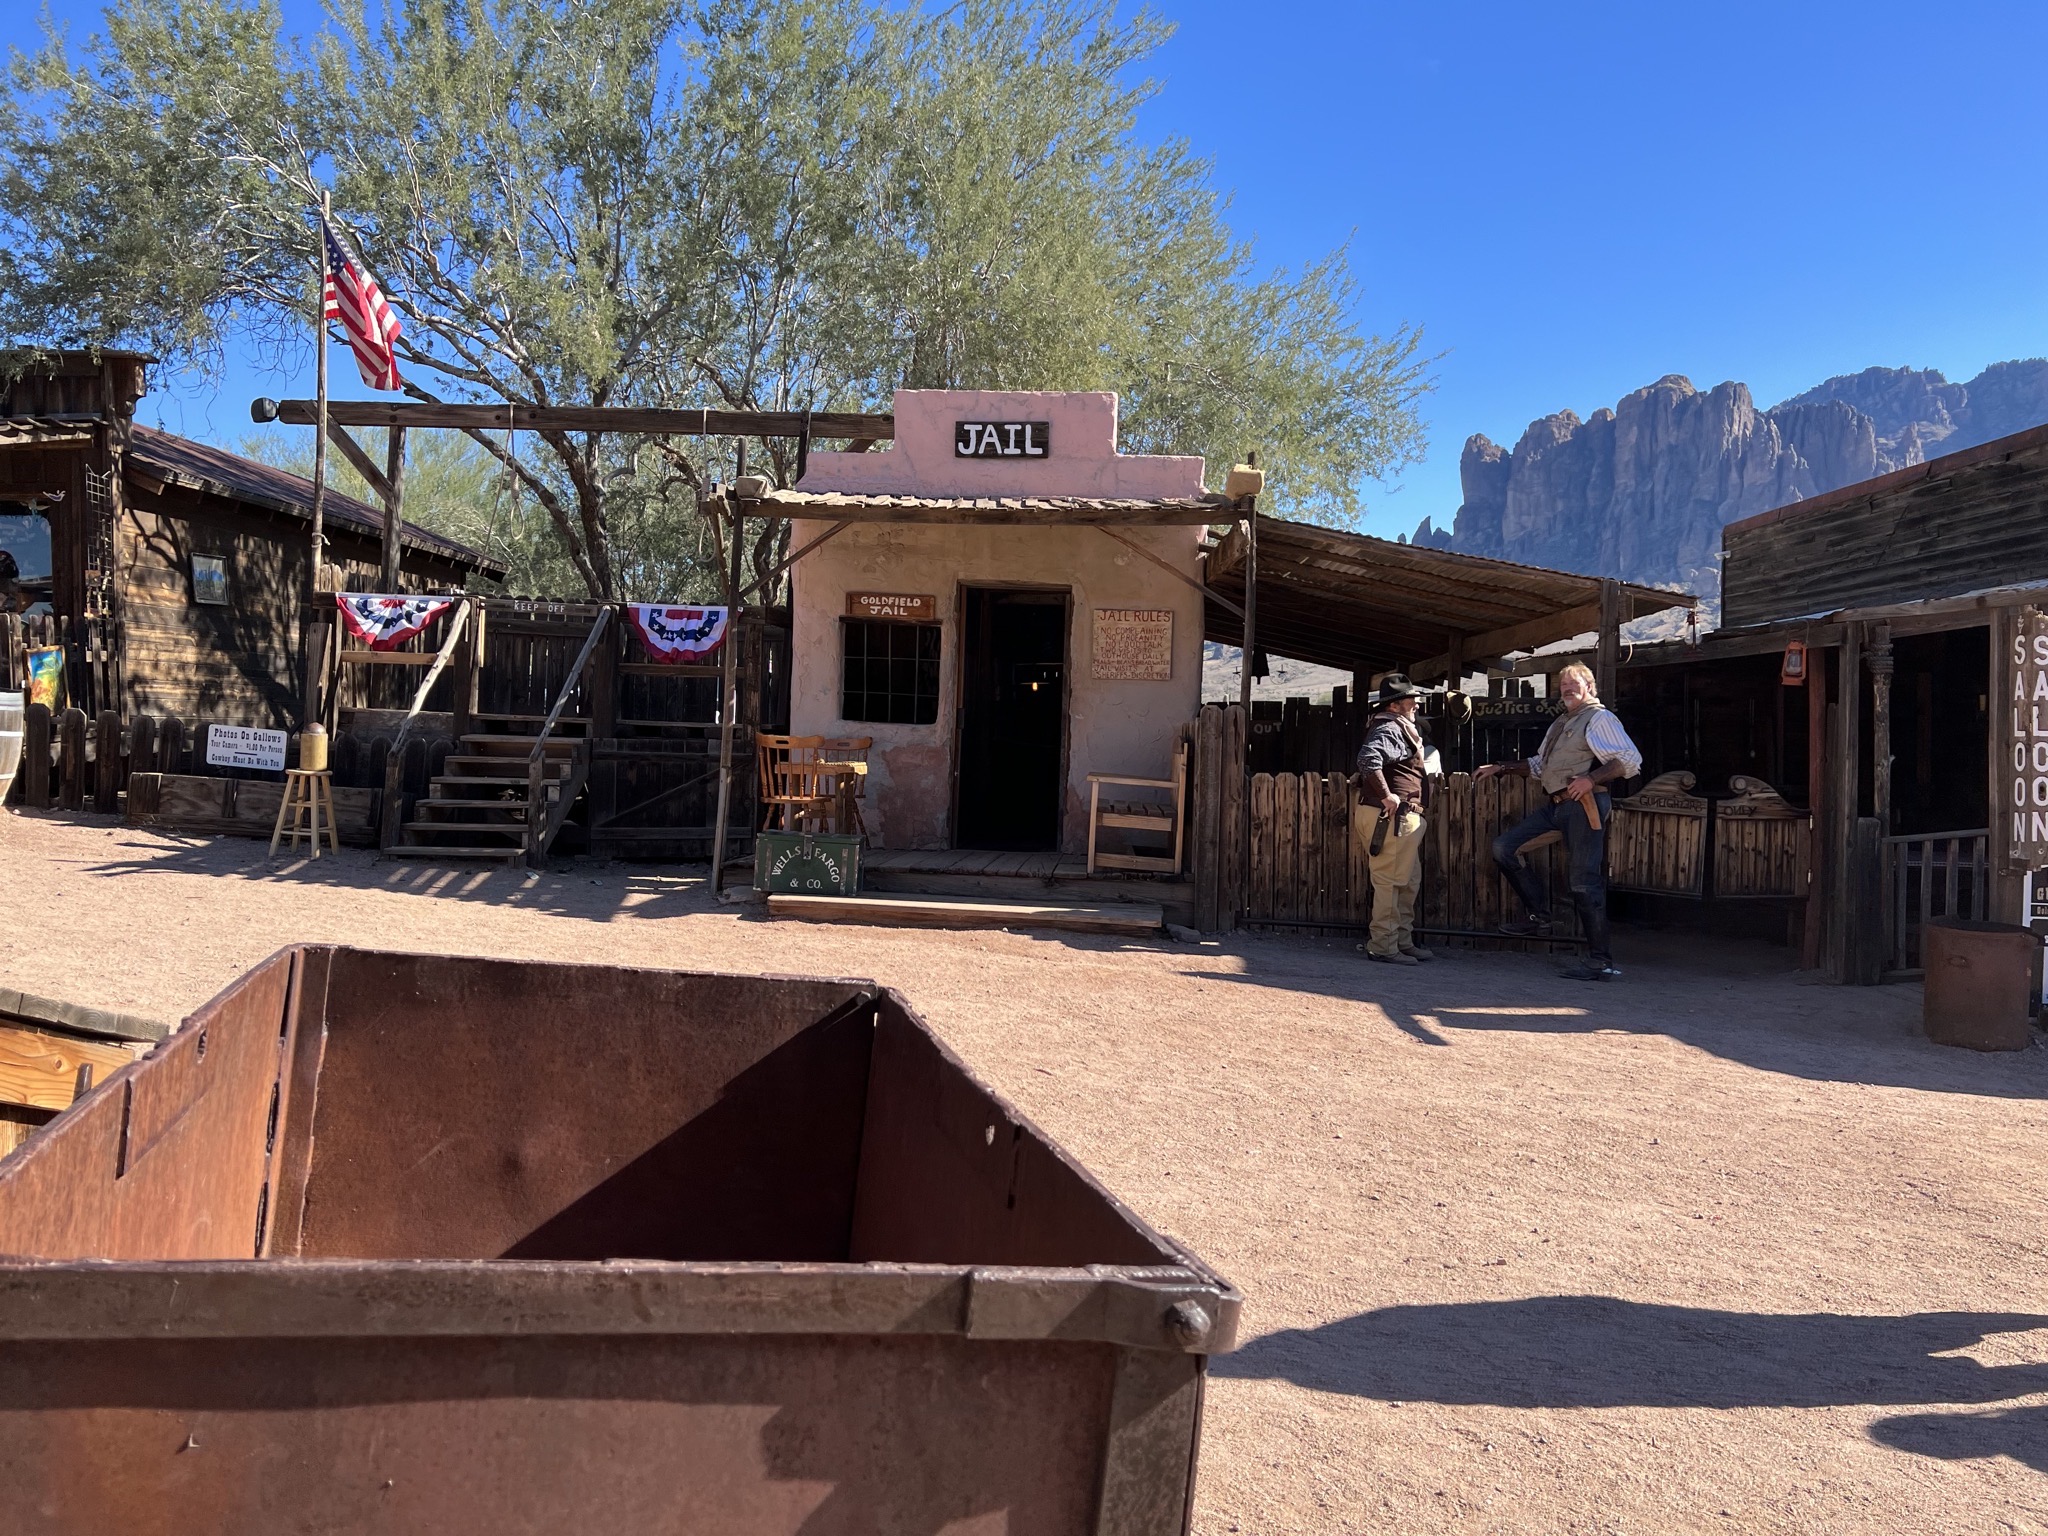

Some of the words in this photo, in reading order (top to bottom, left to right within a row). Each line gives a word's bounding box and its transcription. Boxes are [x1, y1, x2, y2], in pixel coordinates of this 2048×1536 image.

[958, 424, 1043, 455] JAIL
[514, 602, 539, 611] KEEP
[548, 605, 566, 613] OFF
[860, 596, 922, 607] GOLDFIELD
[869, 606, 908, 616] JAIL
[1100, 610, 1130, 622] JAIL
[1133, 610, 1171, 622] RULES
[1100, 627, 1112, 635] NO
[1115, 627, 1168, 635] COMPLAINING
[1120, 634, 1164, 642] PROFANITY
[1253, 722, 1282, 735] OUT
[214, 728, 238, 739] Photos
[240, 730, 250, 740] On
[253, 732, 281, 743] Gallows
[2013, 634, 2026, 842] SALOON
[211, 753, 231, 763] Cowboy
[232, 755, 246, 764] Must
[256, 758, 268, 766] With
[771, 845, 801, 877] WELLS
[814, 847, 841, 883] FARGO
[789, 877, 799, 888] &
[806, 879, 823, 889] CO.
